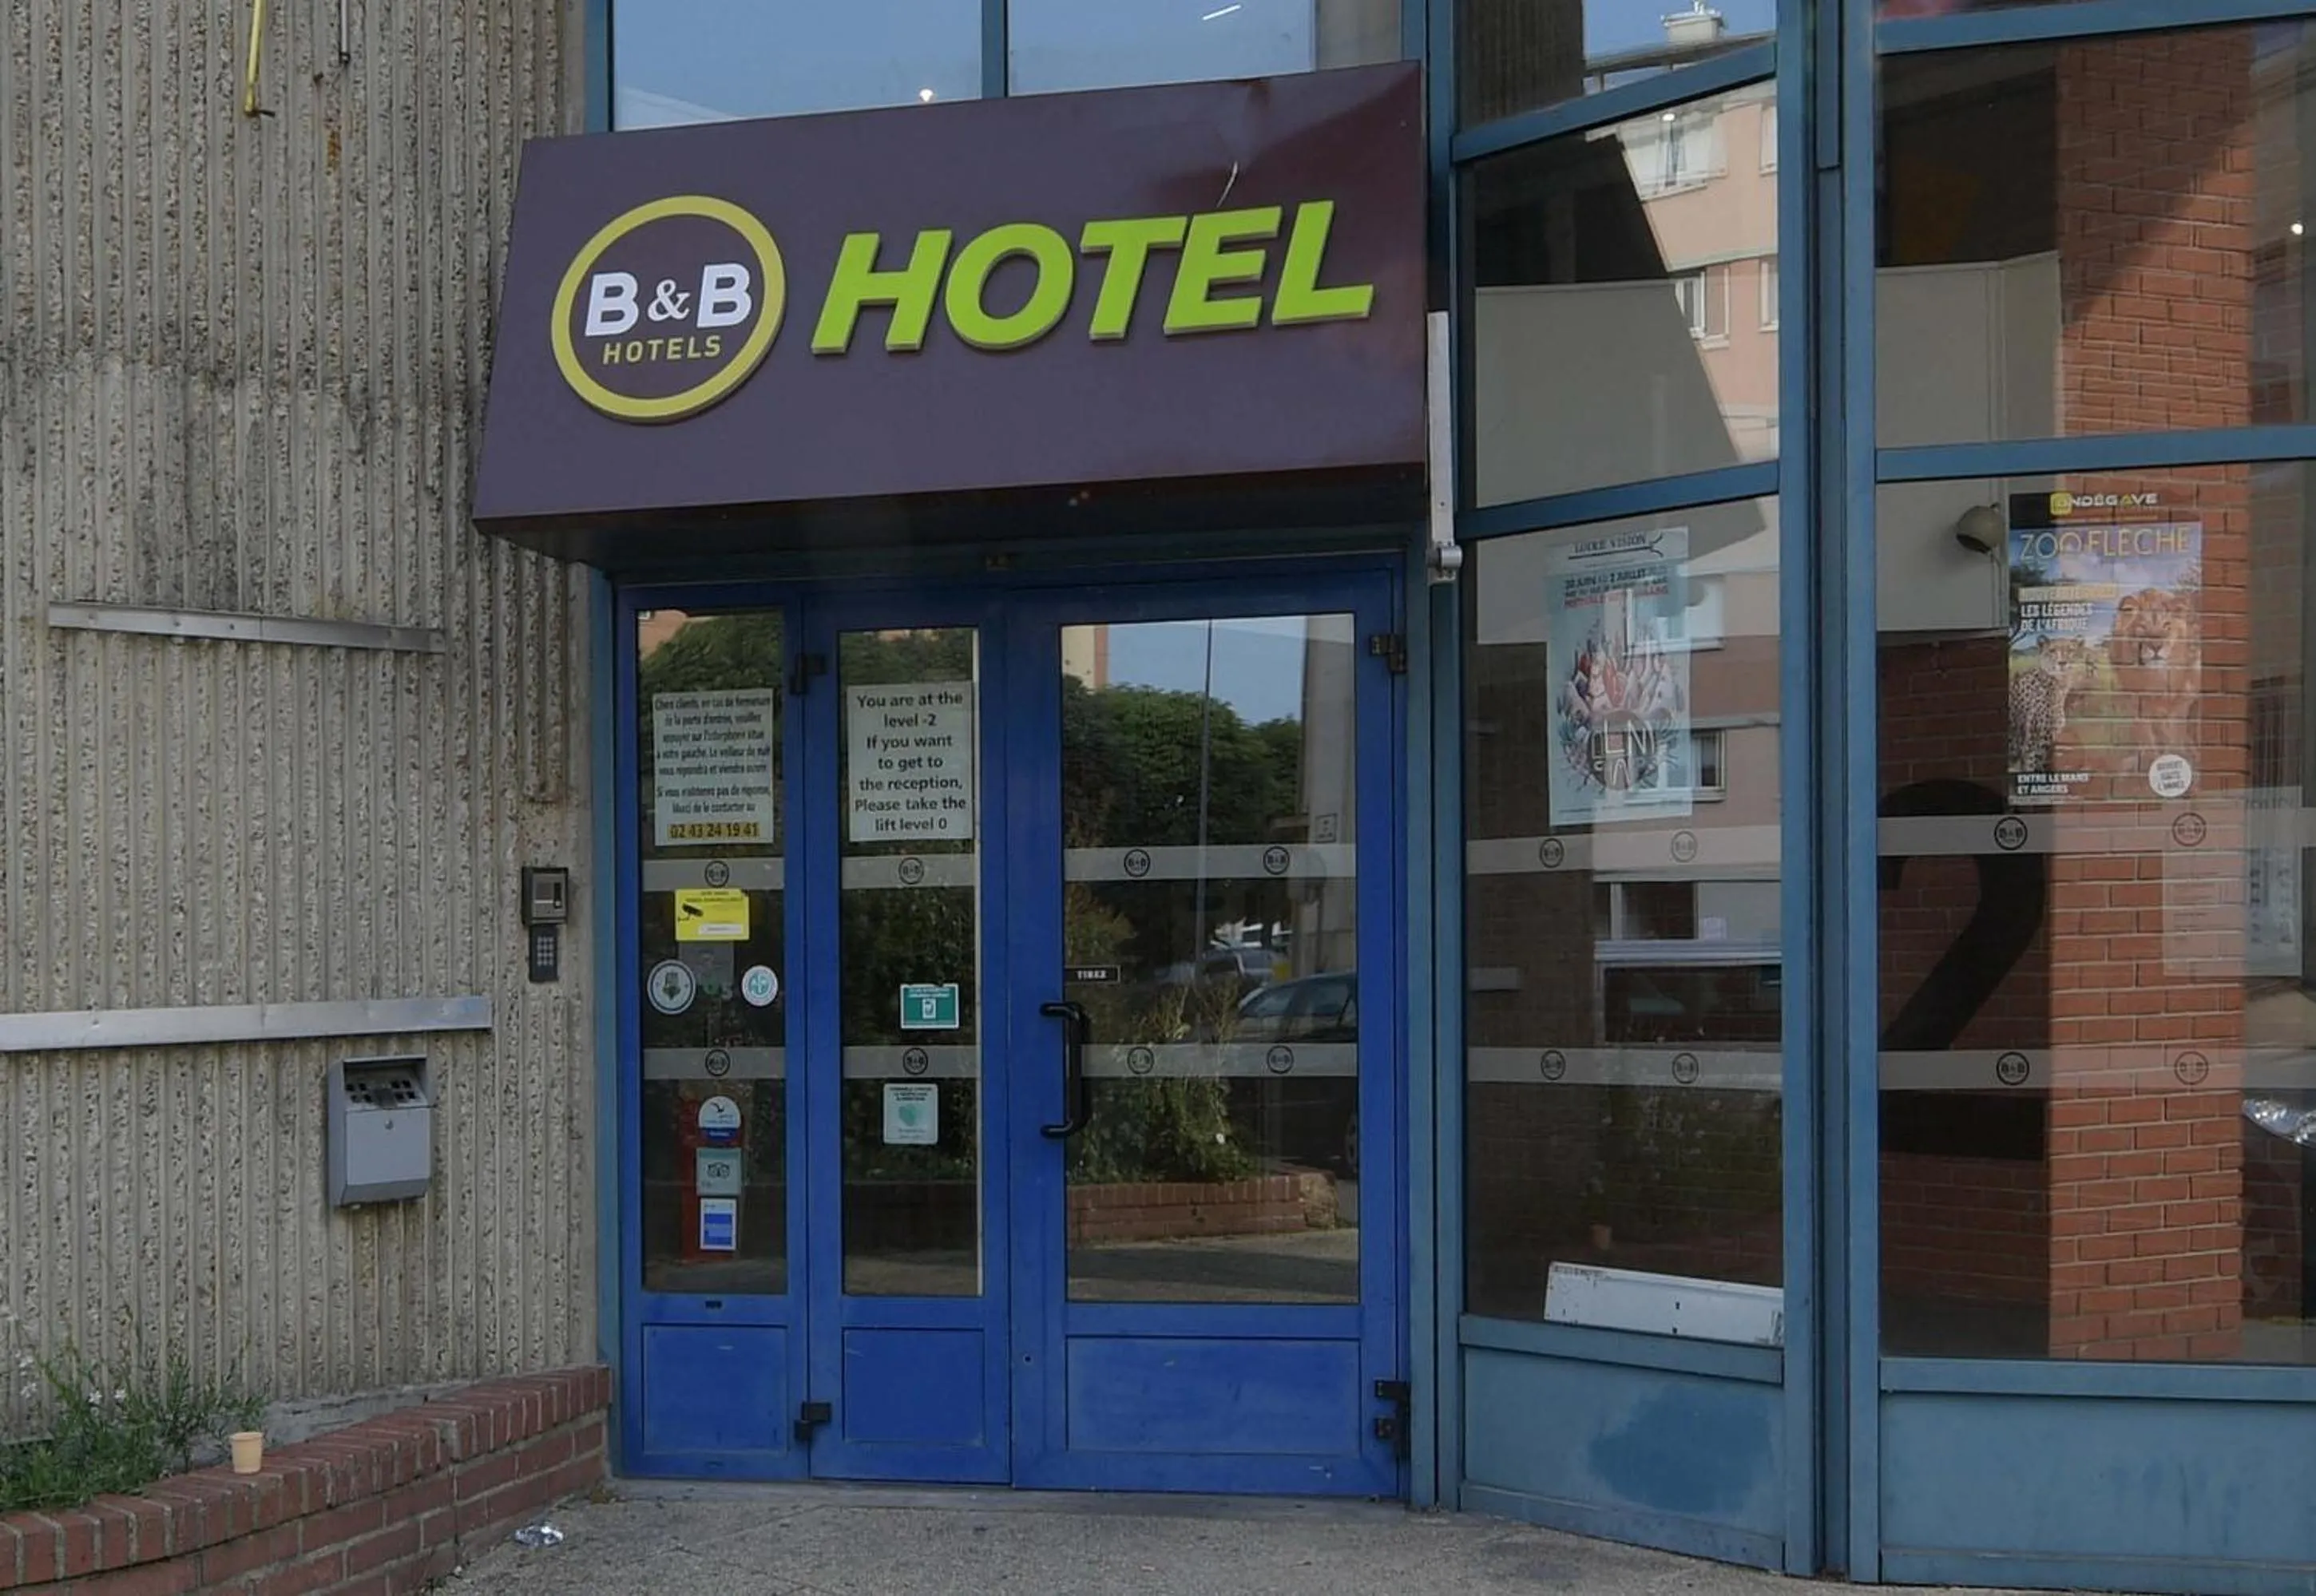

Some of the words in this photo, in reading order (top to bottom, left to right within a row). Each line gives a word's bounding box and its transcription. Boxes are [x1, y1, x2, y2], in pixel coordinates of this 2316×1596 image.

[811, 200, 1374, 354] HOTEL
[584, 263, 753, 336] B&B
[603, 335, 722, 365] HOTELS
[857, 695, 886, 708] You
[890, 695, 914, 707] are
[918, 694, 932, 706] at
[938, 691, 963, 704] the
[884, 714, 918, 728] level
[922, 714, 938, 727] -2
[867, 735, 878, 749] If
[881, 738, 909, 751] you
[914, 735, 953, 747] want
[878, 758, 894, 770] to
[898, 758, 923, 772] get
[927, 756, 943, 768] to
[859, 778, 883, 791] the
[855, 798, 901, 812] Please
[906, 798, 938, 810] take
[942, 797, 966, 810] the
[874, 818, 896, 831] lift
[899, 817, 934, 830] level
[938, 818, 947, 830] 0
